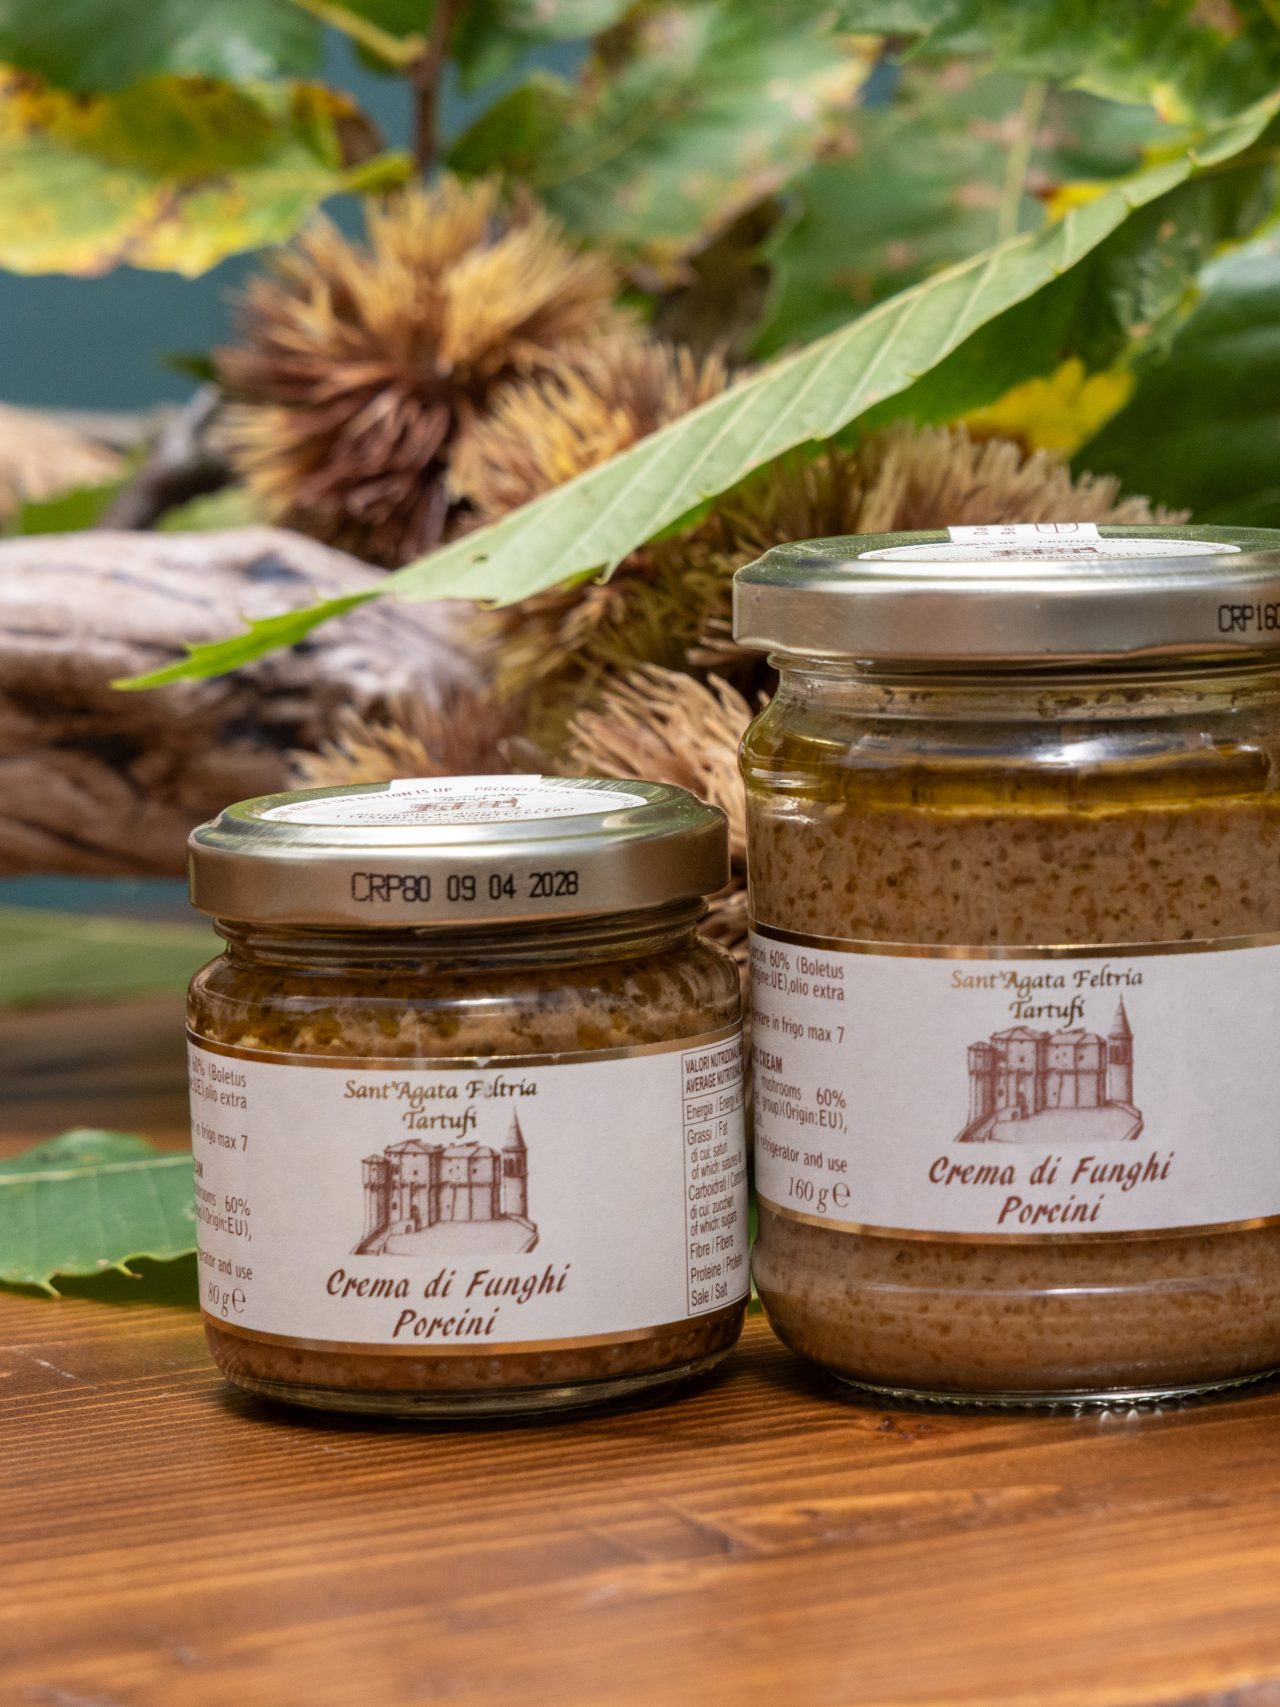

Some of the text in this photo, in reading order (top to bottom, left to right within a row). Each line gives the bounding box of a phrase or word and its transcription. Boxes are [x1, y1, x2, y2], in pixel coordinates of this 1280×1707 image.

[351, 870, 579, 903] CRP80 09 04 2028
[769, 950, 790, 970] 60%
[796, 956, 844, 980] (Boletus
[813, 985, 845, 1001] extra
[951, 964, 1143, 999] Sant'Agata Feltria
[1009, 995, 1085, 1027] Tartufi
[772, 1012, 779, 1030] in
[782, 1014, 804, 1039] frigo
[808, 1024, 832, 1042] max
[837, 1026, 845, 1043] 7
[685, 1054, 710, 1075] VALORI
[759, 1049, 783, 1074] CREAM
[208, 1062, 247, 1088] (Boletus
[686, 1072, 716, 1094] AVERAGE
[220, 1091, 248, 1109] extra
[344, 1079, 458, 1107] Sant'Agata
[761, 1074, 802, 1101] mushrooms
[816, 1086, 847, 1109] 60%
[402, 1105, 478, 1138] Tartufi
[686, 1101, 714, 1121] Energia
[201, 1124, 248, 1152] frigo max 7
[687, 1124, 713, 1146] Grassi
[804, 1148, 823, 1170] and
[828, 1155, 848, 1173] use
[928, 1151, 1175, 1192] Crema di Funghi
[788, 1176, 814, 1202] 160
[225, 1194, 251, 1217] 60%
[997, 1194, 1105, 1225] Porcini
[690, 1242, 711, 1261] Fibre
[218, 1255, 232, 1276] and
[235, 1261, 253, 1282] use
[690, 1262, 721, 1284] Proteine
[208, 1281, 220, 1305] 80
[326, 1263, 571, 1304] Crema di Funghi
[691, 1286, 709, 1307] Sale
[392, 1307, 500, 1338] Porcini
